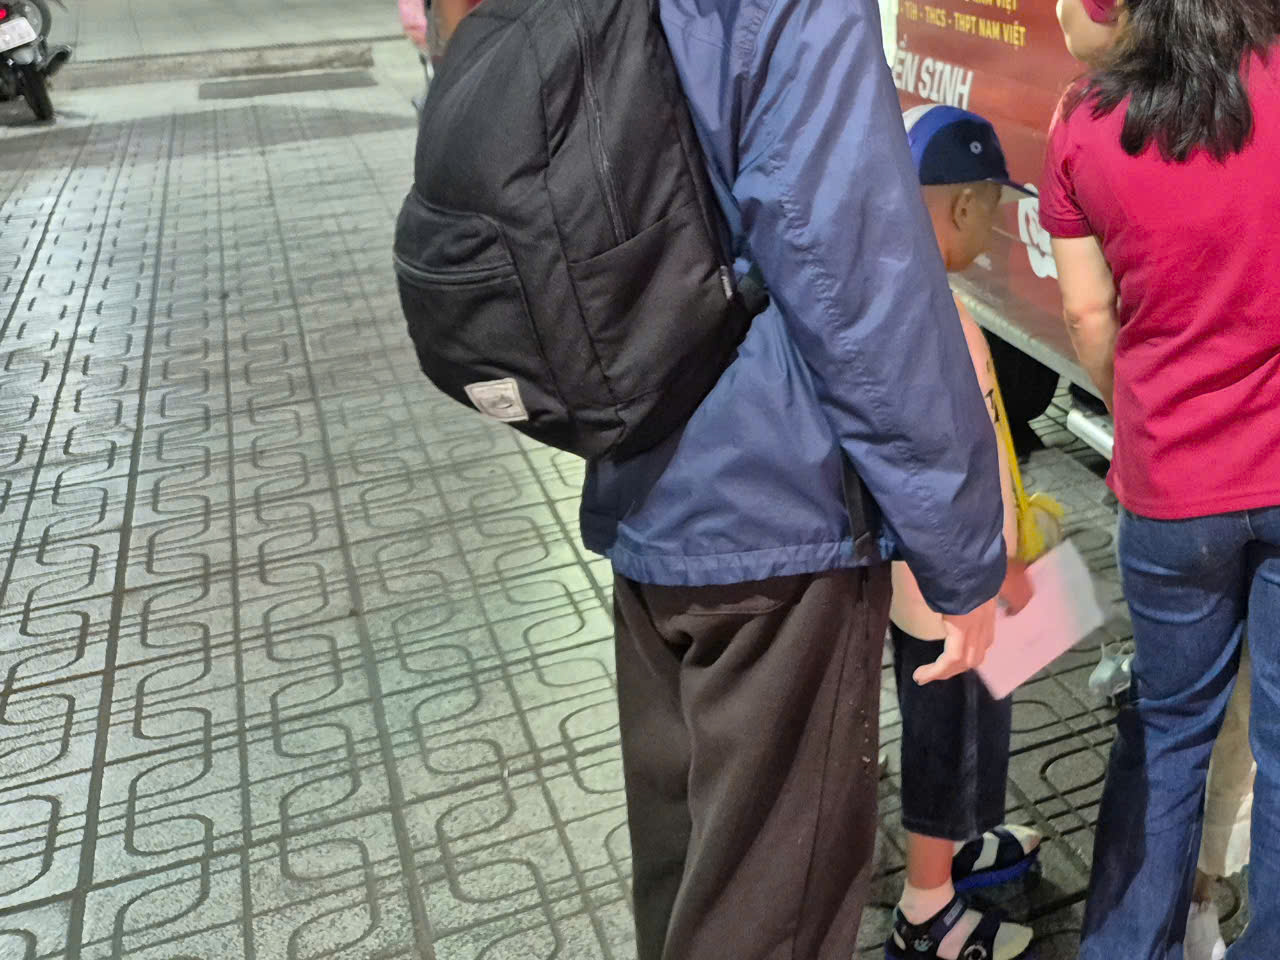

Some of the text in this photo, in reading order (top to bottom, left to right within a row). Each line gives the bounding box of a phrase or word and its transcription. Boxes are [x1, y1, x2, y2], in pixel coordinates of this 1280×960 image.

[978, 17, 1000, 41] NAM
[1002, 20, 1027, 50] VIỆT
[918, 57, 974, 111] SINH
